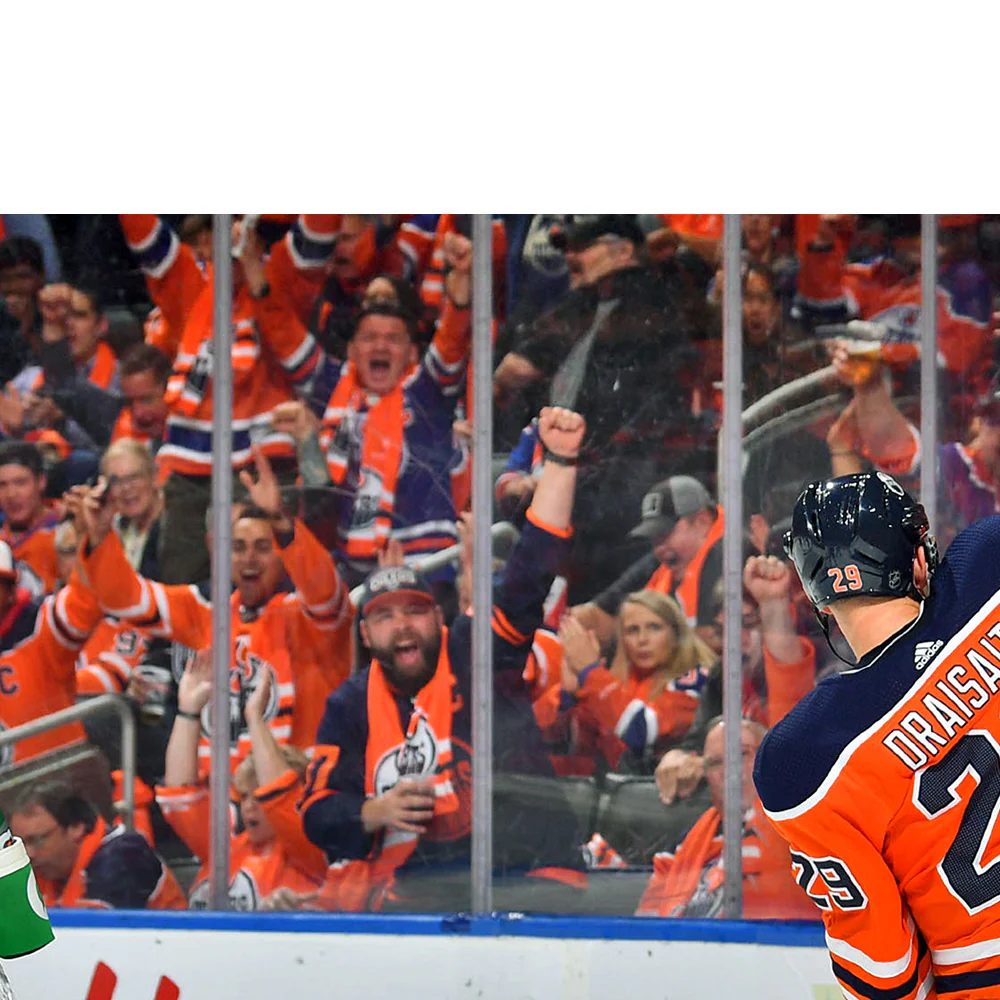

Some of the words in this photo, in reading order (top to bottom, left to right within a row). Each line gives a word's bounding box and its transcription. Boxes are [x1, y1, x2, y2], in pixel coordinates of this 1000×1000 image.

[827, 564, 863, 593] 29
[915, 639, 944, 671] adidas
[789, 846, 869, 912] 29
